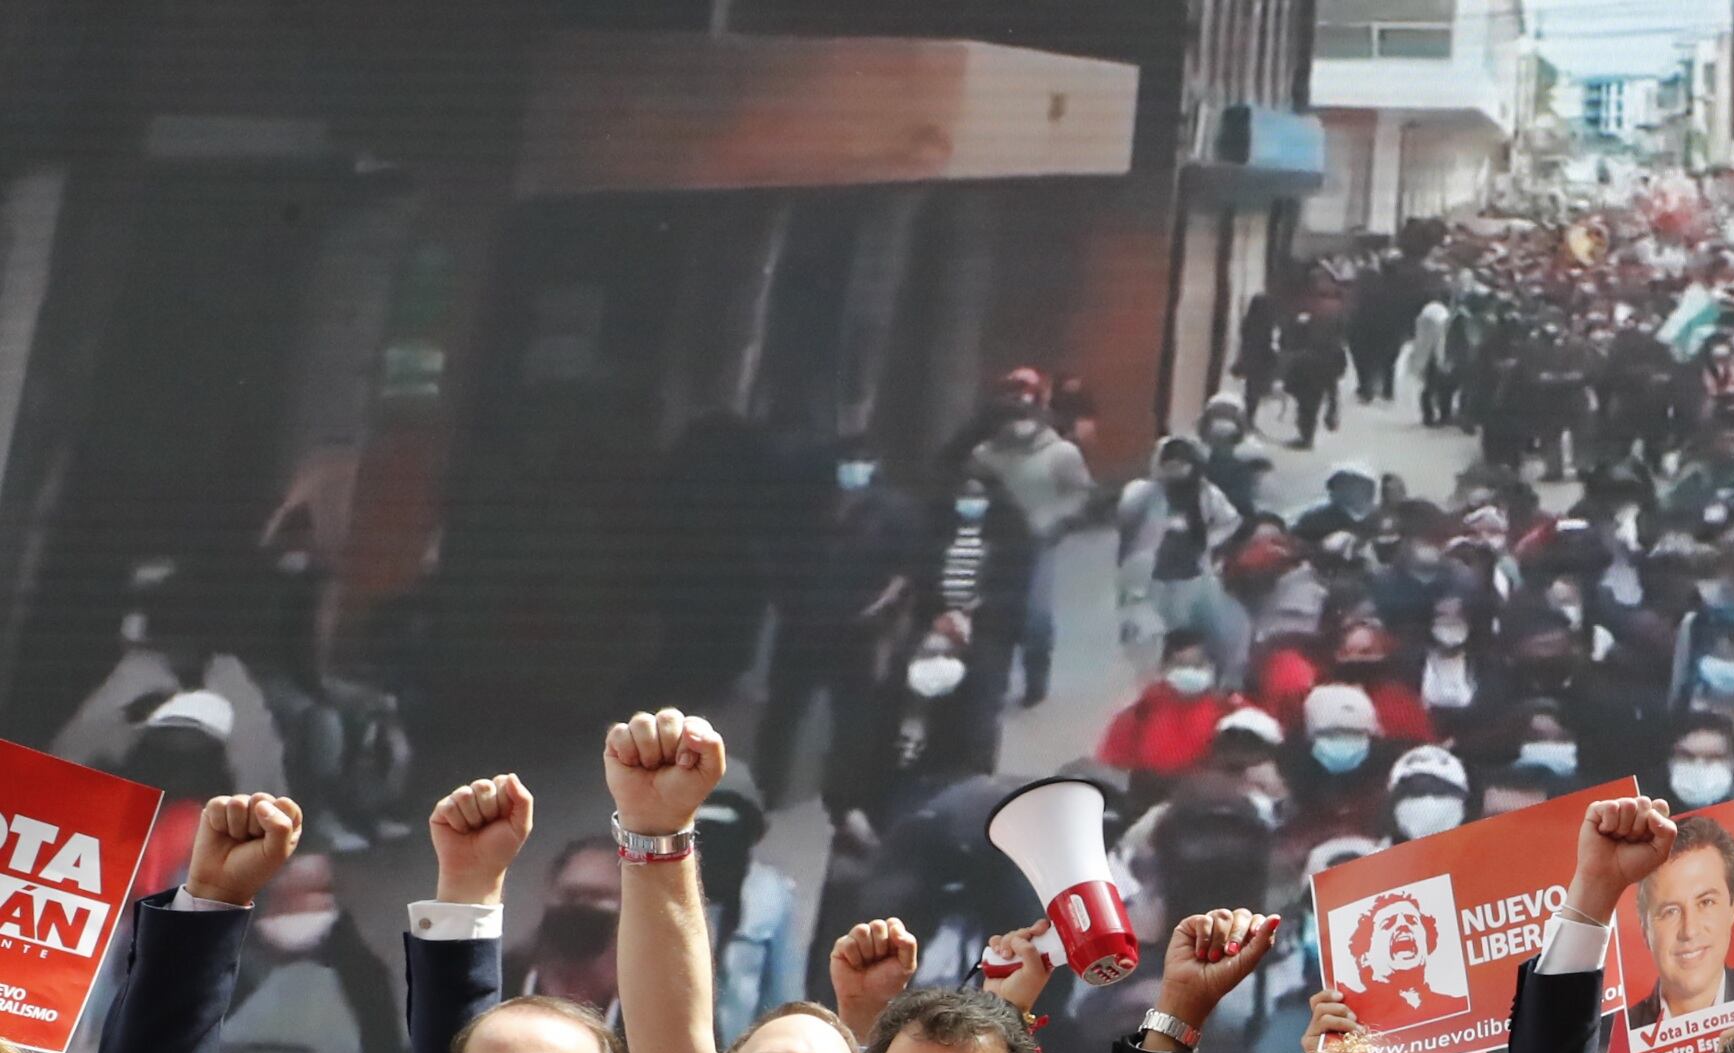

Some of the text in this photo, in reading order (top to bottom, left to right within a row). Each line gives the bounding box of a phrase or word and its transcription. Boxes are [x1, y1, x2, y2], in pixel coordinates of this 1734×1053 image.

[0, 812, 101, 894] TA
[0, 885, 91, 949] ÁN
[1461, 885, 1568, 935] NUEVO
[1466, 923, 1543, 966] LIBER
[1685, 1021, 1699, 1034] la
[1697, 1036, 1720, 1053] Esp
